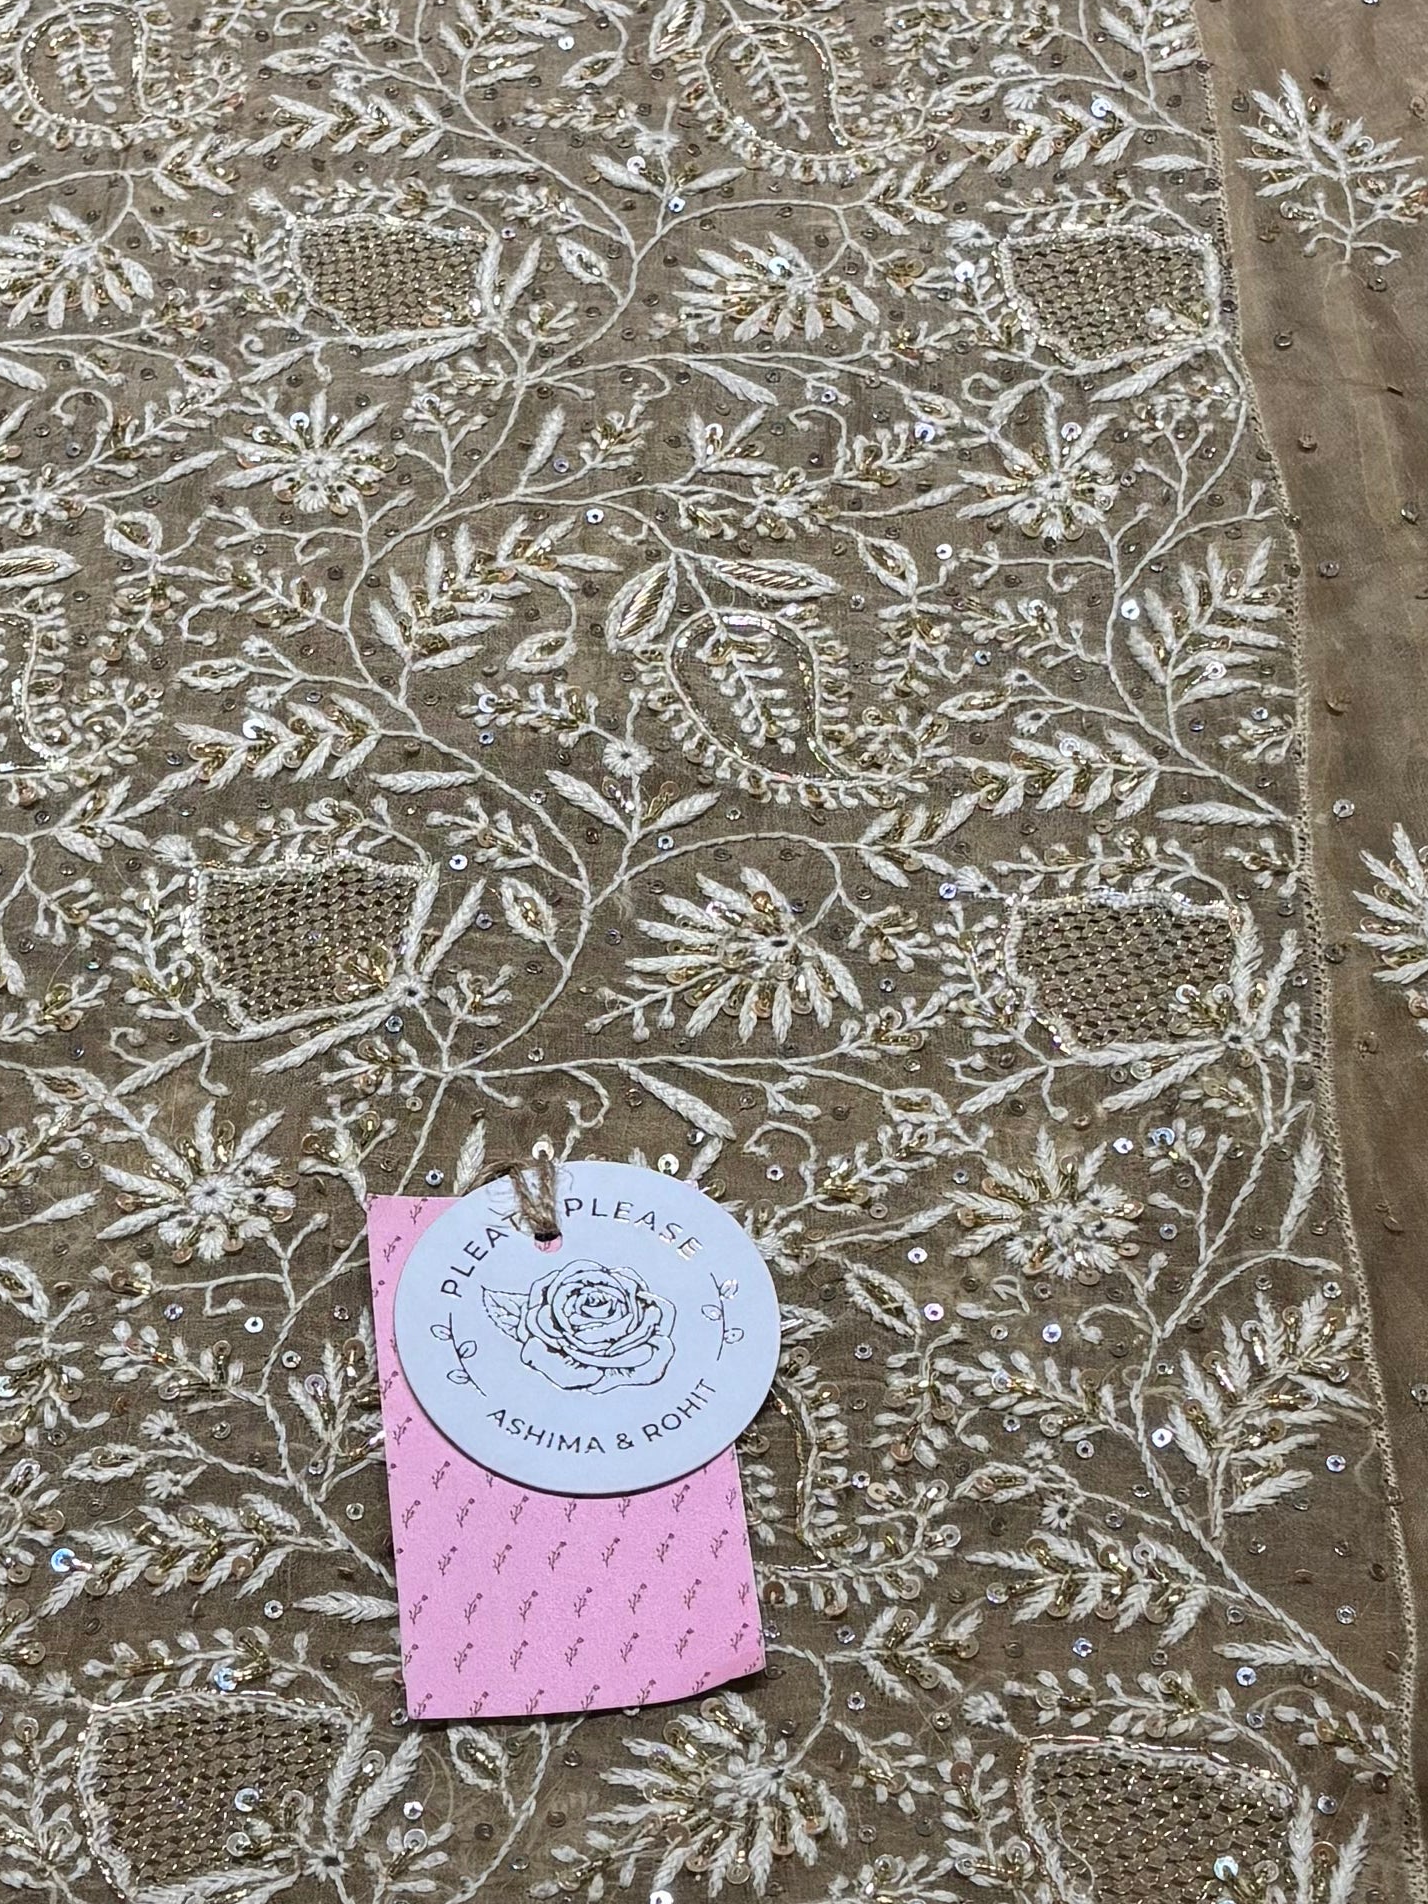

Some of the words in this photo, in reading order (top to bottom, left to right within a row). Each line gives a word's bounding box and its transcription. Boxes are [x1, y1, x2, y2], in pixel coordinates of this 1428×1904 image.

[564, 1197, 703, 1261] PLEASE
[487, 1408, 605, 1455] ASHIMA
[616, 1433, 635, 1450] &
[642, 1378, 717, 1443] ROHIT
